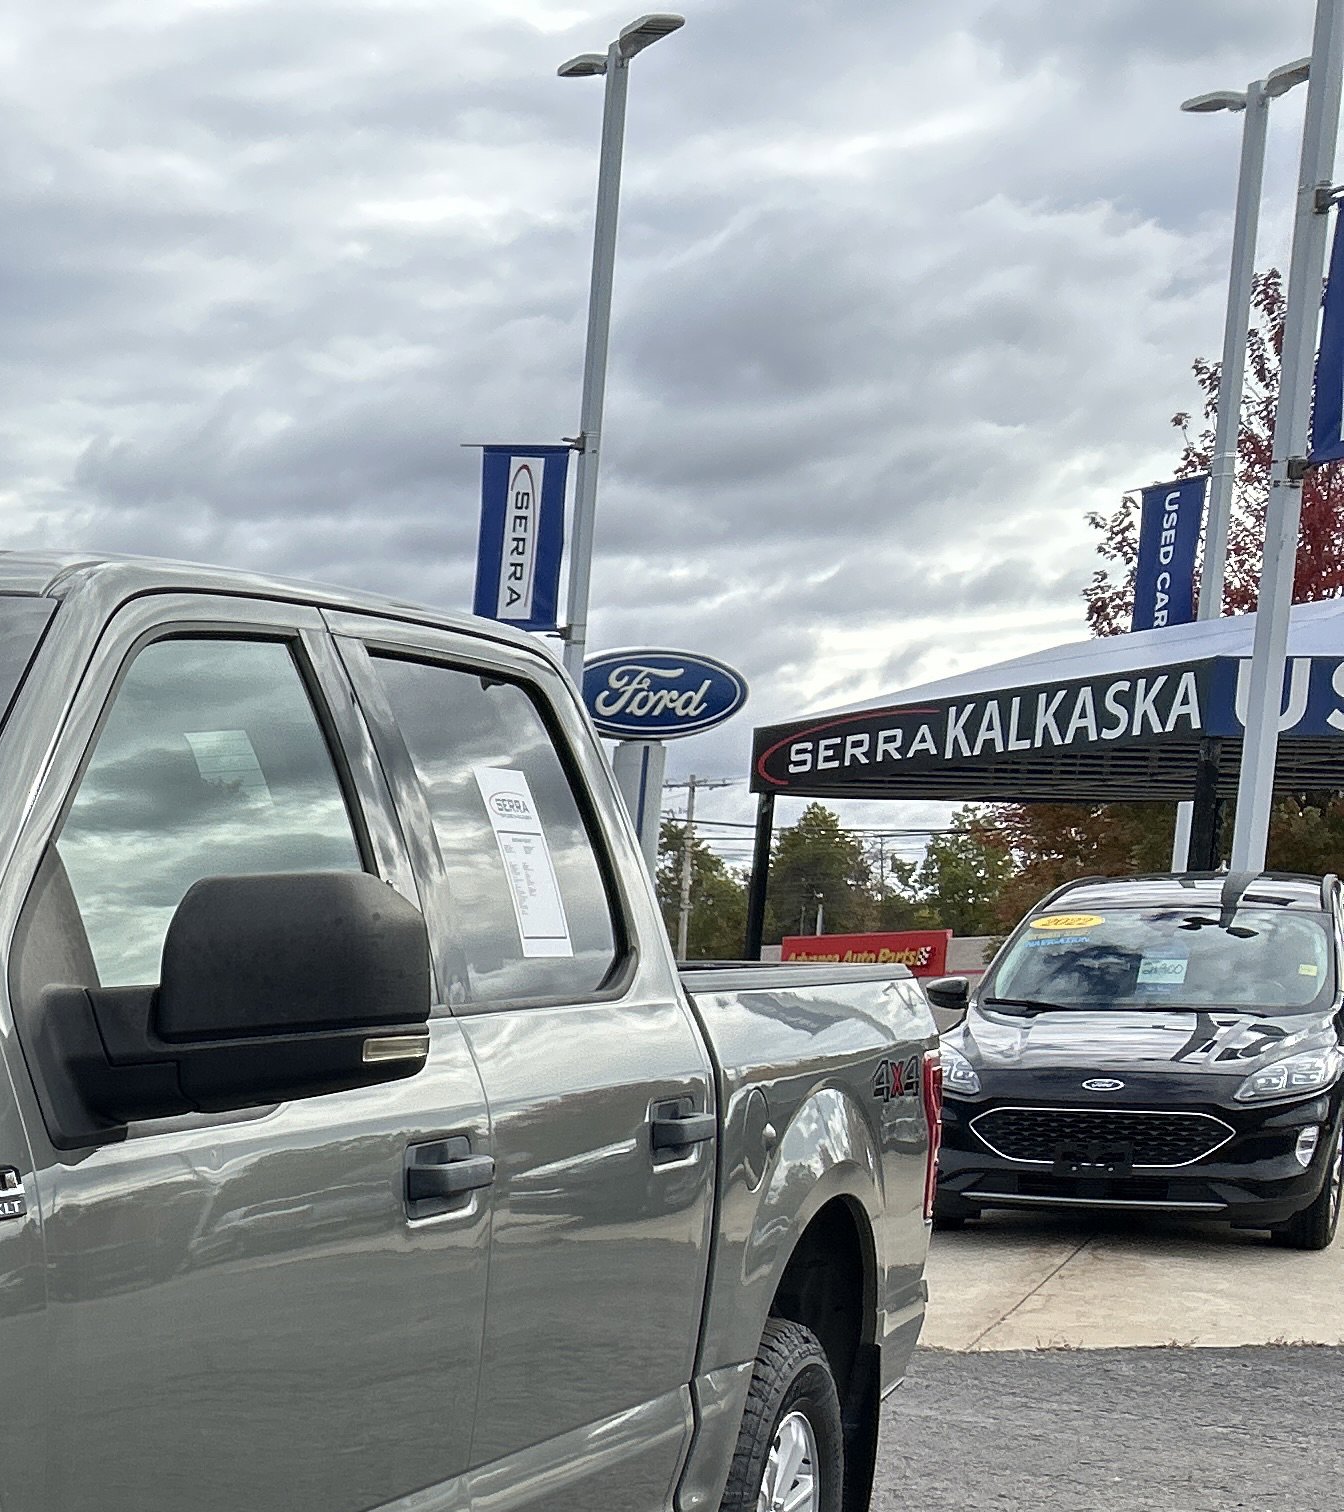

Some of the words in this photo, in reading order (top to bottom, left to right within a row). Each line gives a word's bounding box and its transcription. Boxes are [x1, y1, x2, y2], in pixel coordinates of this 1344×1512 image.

[506, 490, 530, 607] SERRA
[1159, 491, 1181, 565] USED
[595, 665, 712, 717] Ford
[787, 725, 938, 774] SERRA
[944, 671, 1202, 760] KALKASKA
[494, 797, 530, 813] SERRA
[879, 947, 917, 966] Parts
